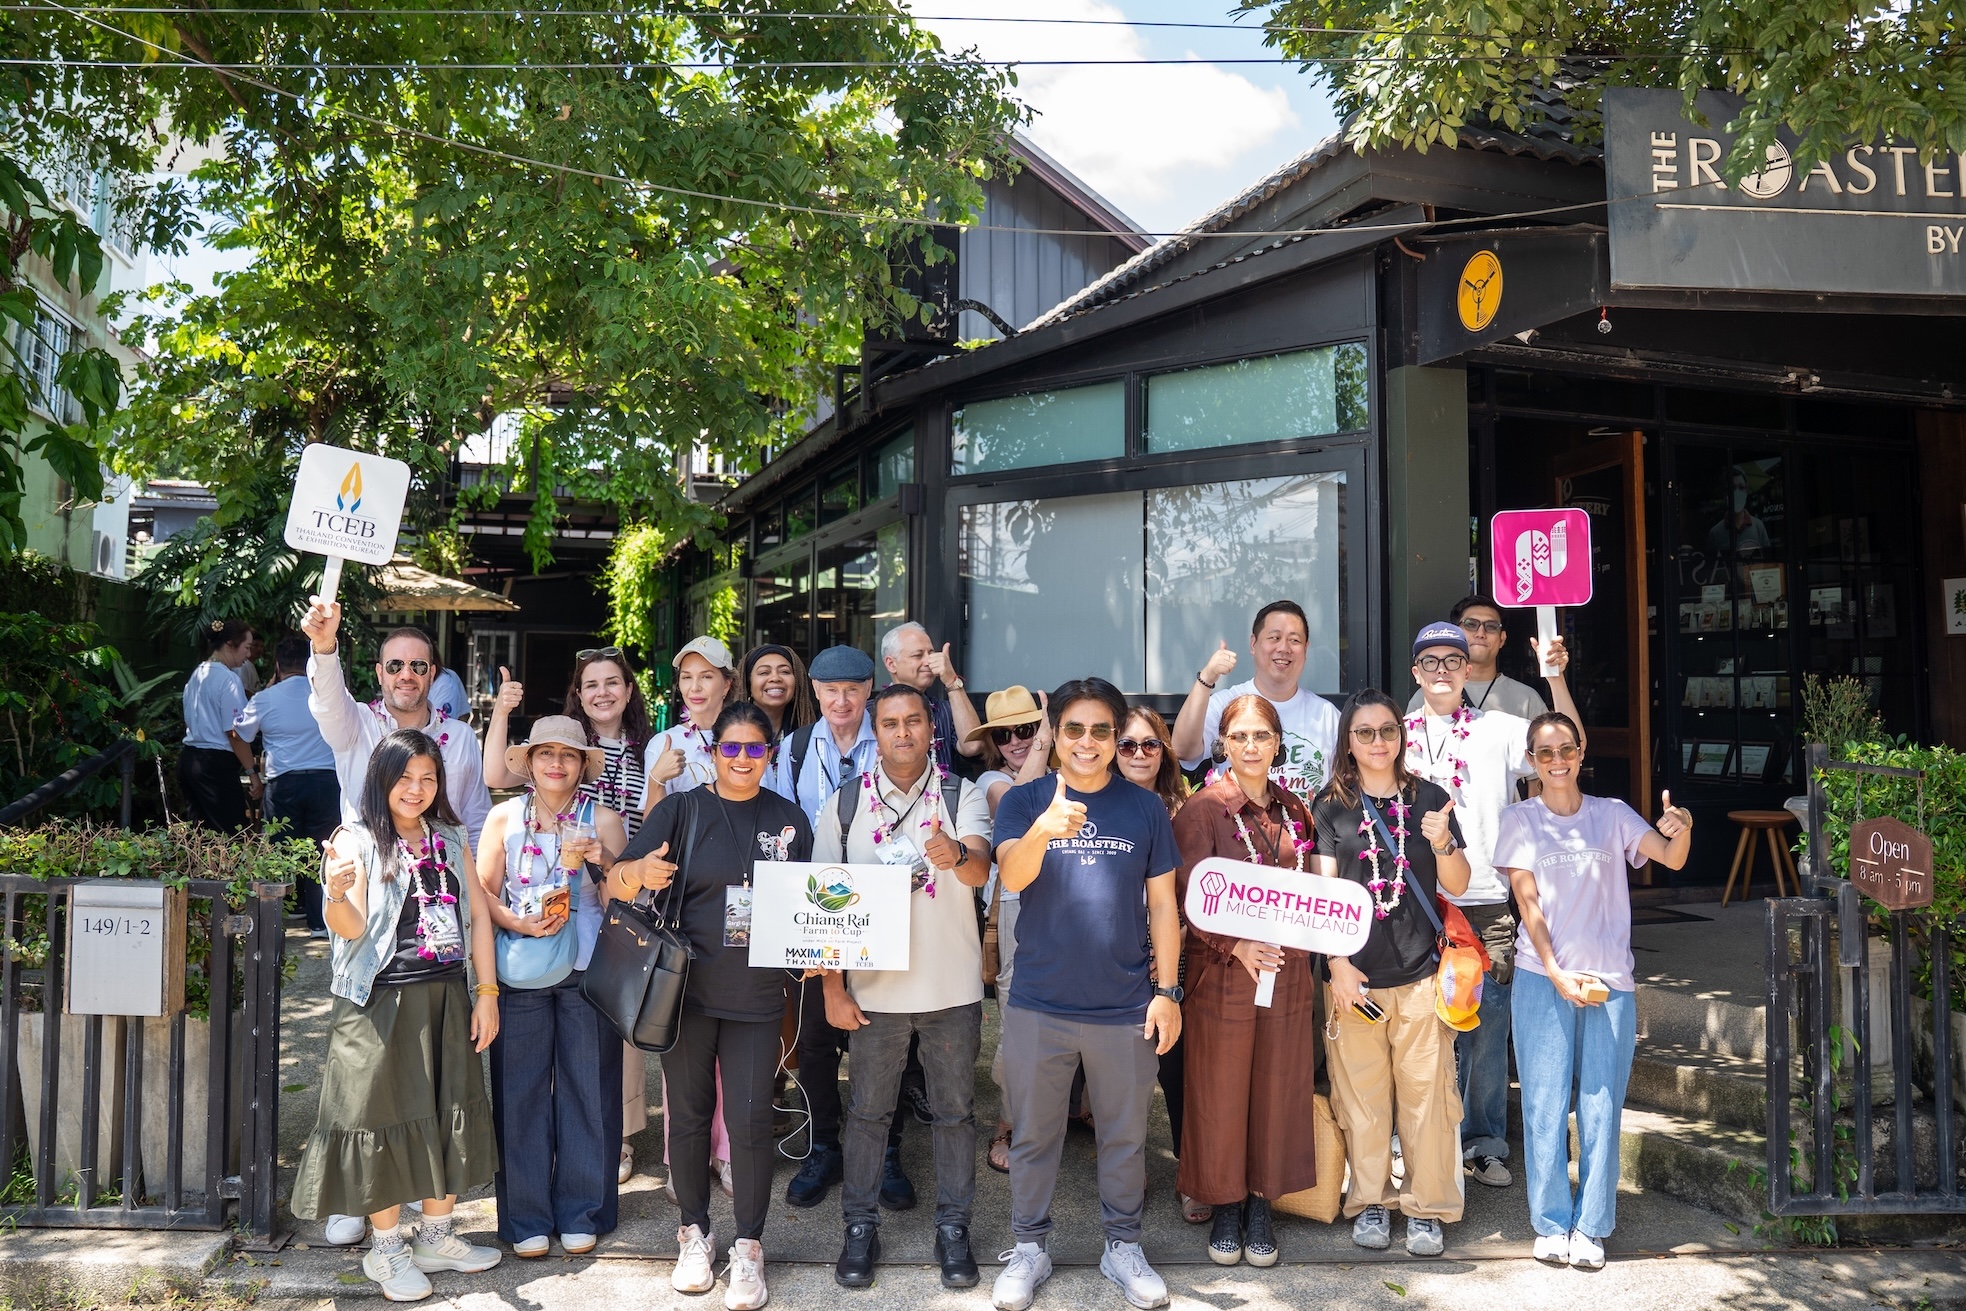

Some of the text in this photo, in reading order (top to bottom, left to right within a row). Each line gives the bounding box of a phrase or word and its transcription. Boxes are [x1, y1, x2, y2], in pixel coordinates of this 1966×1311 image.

[1651, 131, 1678, 193] THE
[1926, 225, 1965, 254] BY
[312, 510, 376, 538] TCEB
[296, 527, 385, 550] THAILAND CONVENTION
[306, 536, 348, 549] EXHIBITION
[350, 545, 380, 556] BUREAU
[1046, 839, 1134, 853] THE ROASTERY
[1560, 852, 1612, 863] ROASTERY
[1870, 831, 1909, 864] Open
[1859, 865, 1866, 880] 8
[1869, 871, 1883, 884] am
[1895, 873, 1901, 888] 5
[1905, 880, 1921, 895] pm
[1228, 882, 1362, 922] NORTHERN
[83, 916, 151, 936] 149/1-2
[794, 912, 870, 929] Chiang Rai
[1226, 901, 1359, 936] MICE THAILAND
[803, 926, 828, 934] Farm
[843, 927, 862, 937] Cup
